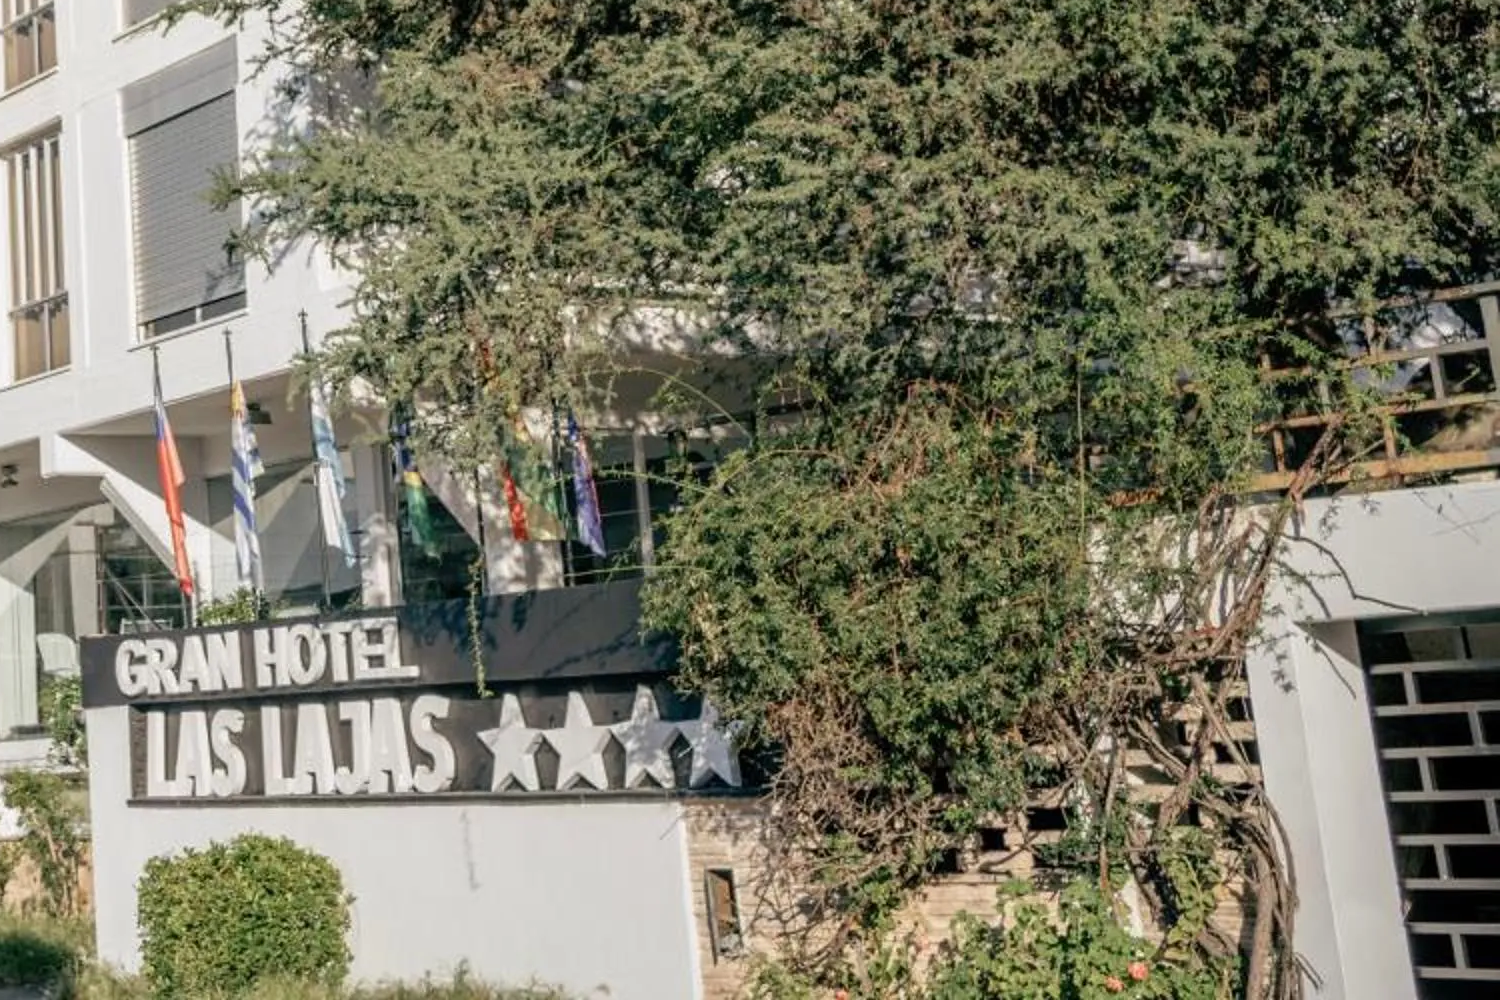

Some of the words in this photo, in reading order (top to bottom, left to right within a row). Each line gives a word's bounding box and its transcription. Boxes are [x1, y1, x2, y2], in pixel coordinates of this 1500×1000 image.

[115, 630, 244, 697] GRAN
[253, 617, 420, 688] HOTEL
[147, 709, 247, 797] LAS
[260, 694, 457, 796] LAJAS
